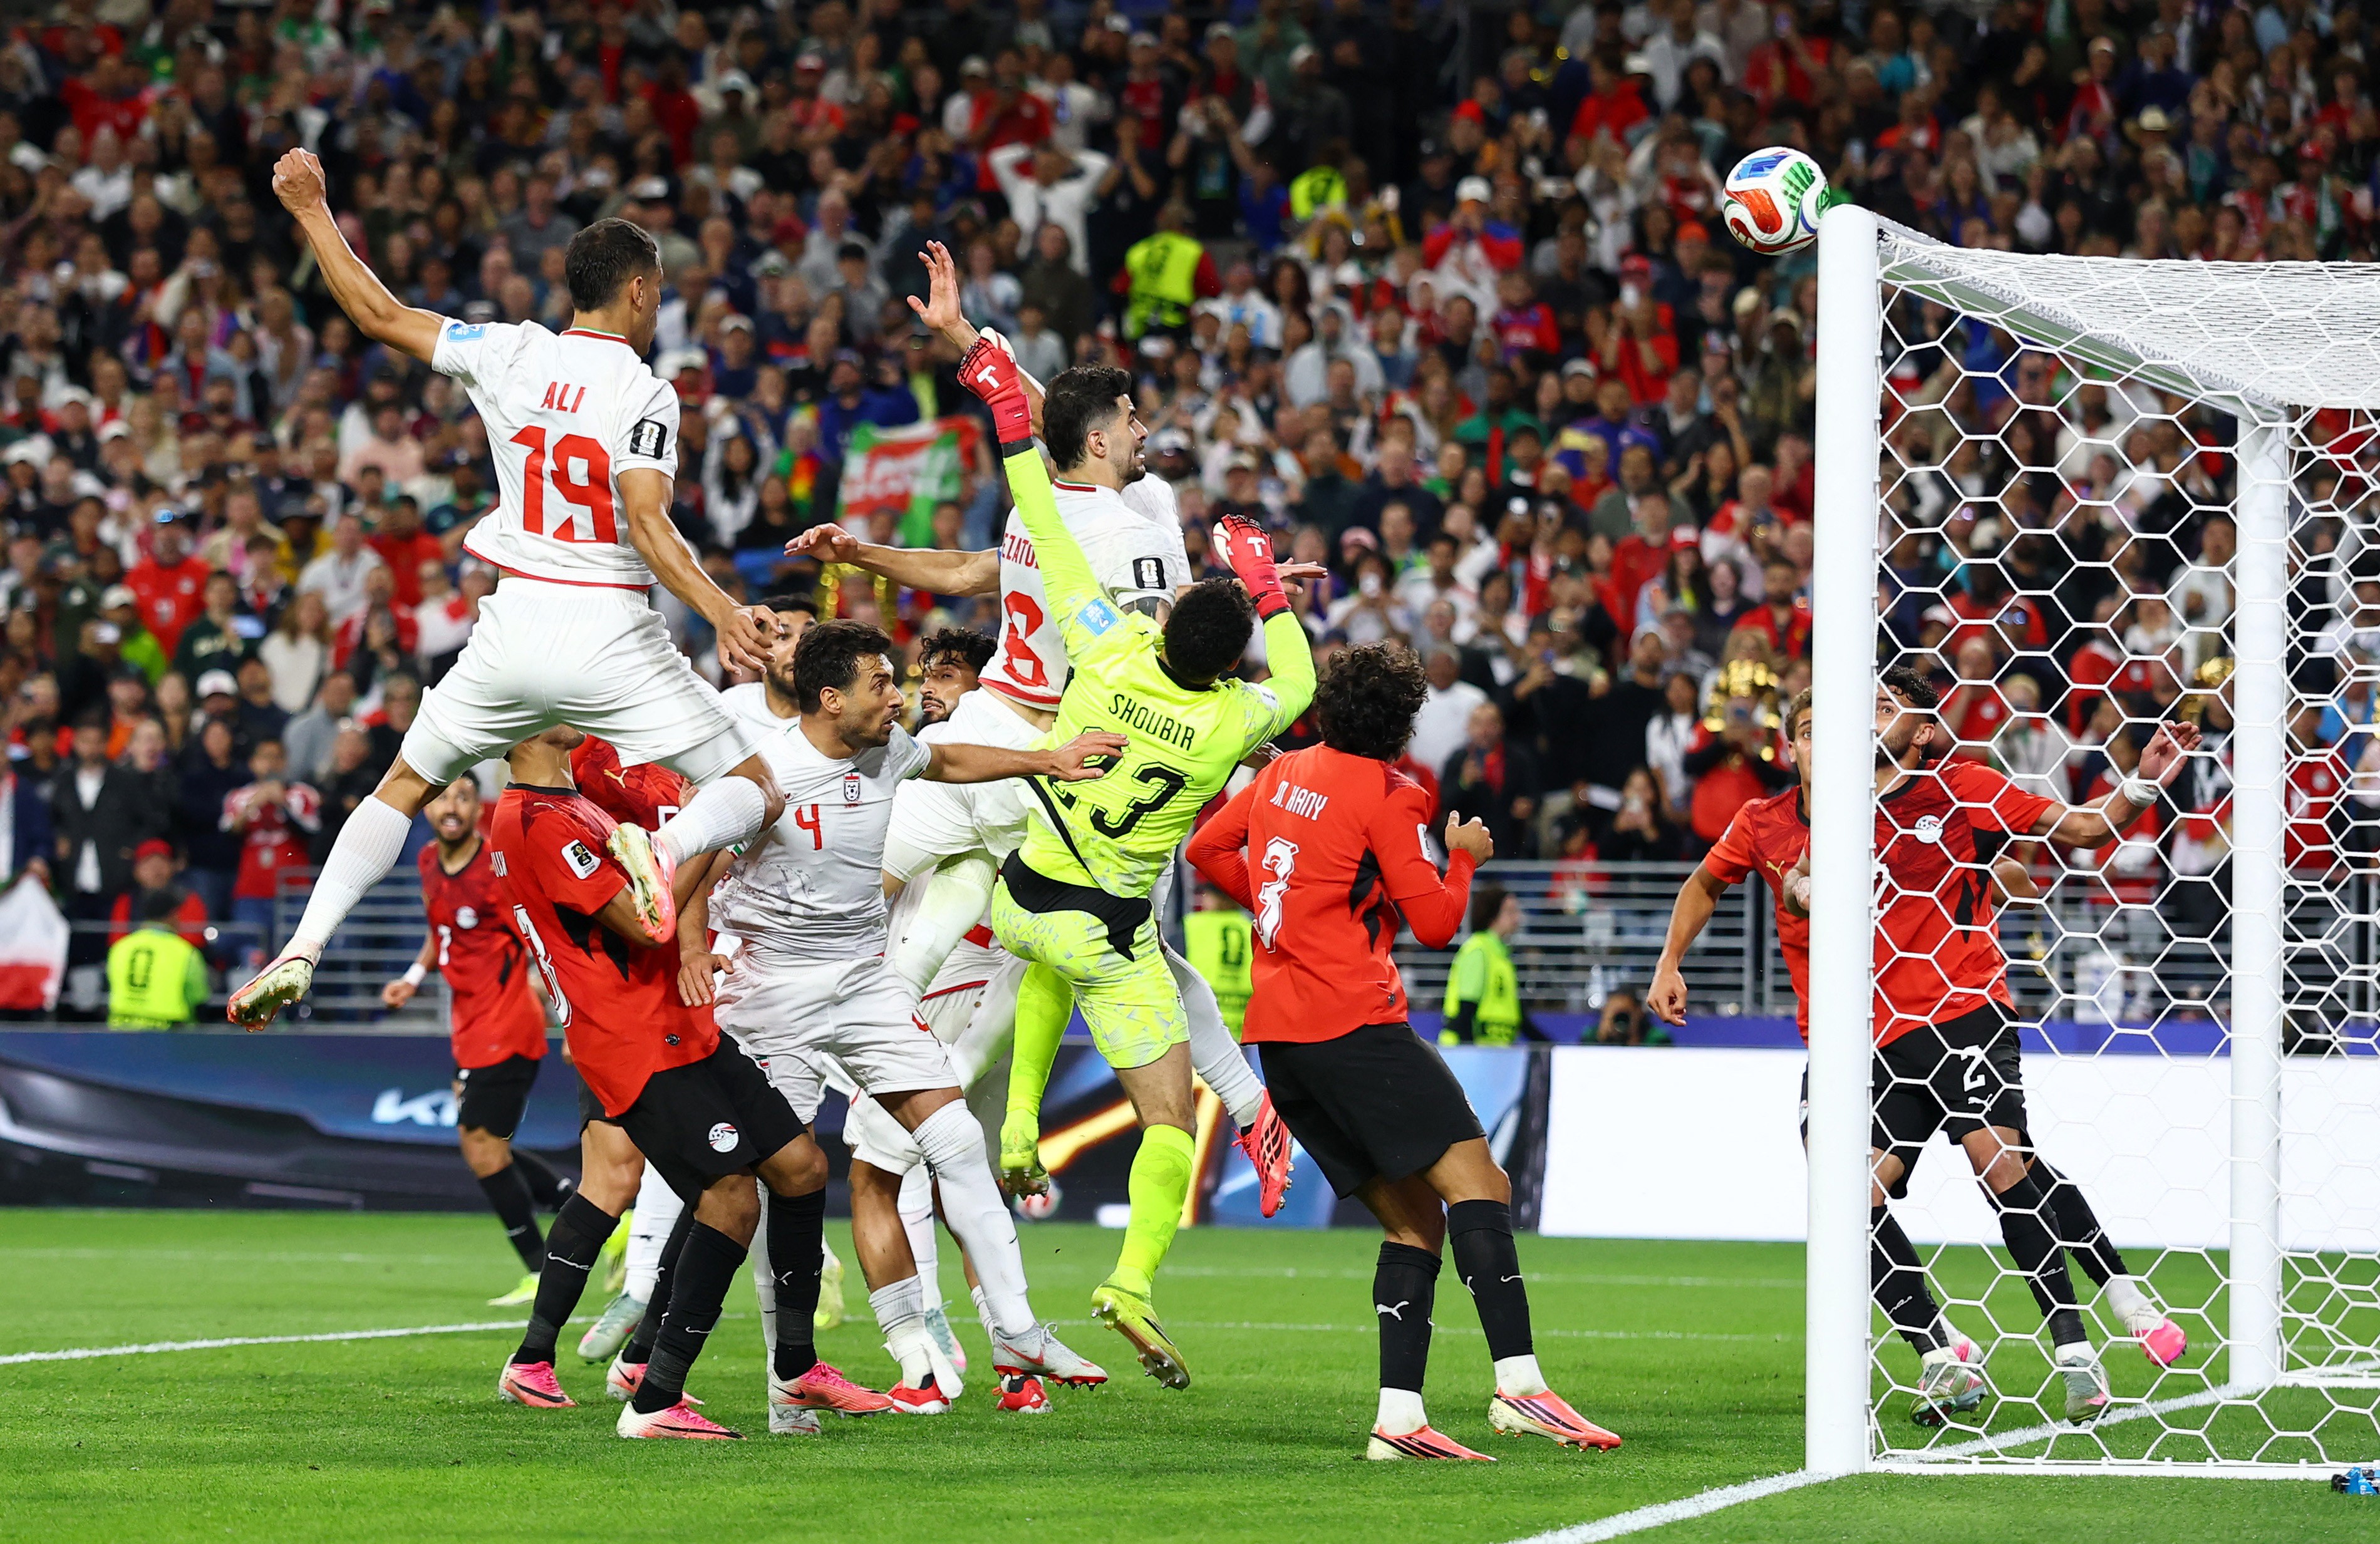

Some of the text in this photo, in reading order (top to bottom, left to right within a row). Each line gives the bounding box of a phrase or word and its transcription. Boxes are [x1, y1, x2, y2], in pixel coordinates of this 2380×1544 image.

[540, 381, 586, 414] ALI
[509, 425, 618, 544] 19
[1003, 590, 1049, 687] 8
[1109, 694, 1195, 751] SHOUBIR
[1269, 780, 1328, 821] M. HANY
[795, 804, 822, 850] 4
[1253, 836, 1299, 954] 3
[1961, 1044, 1986, 1092] 2
